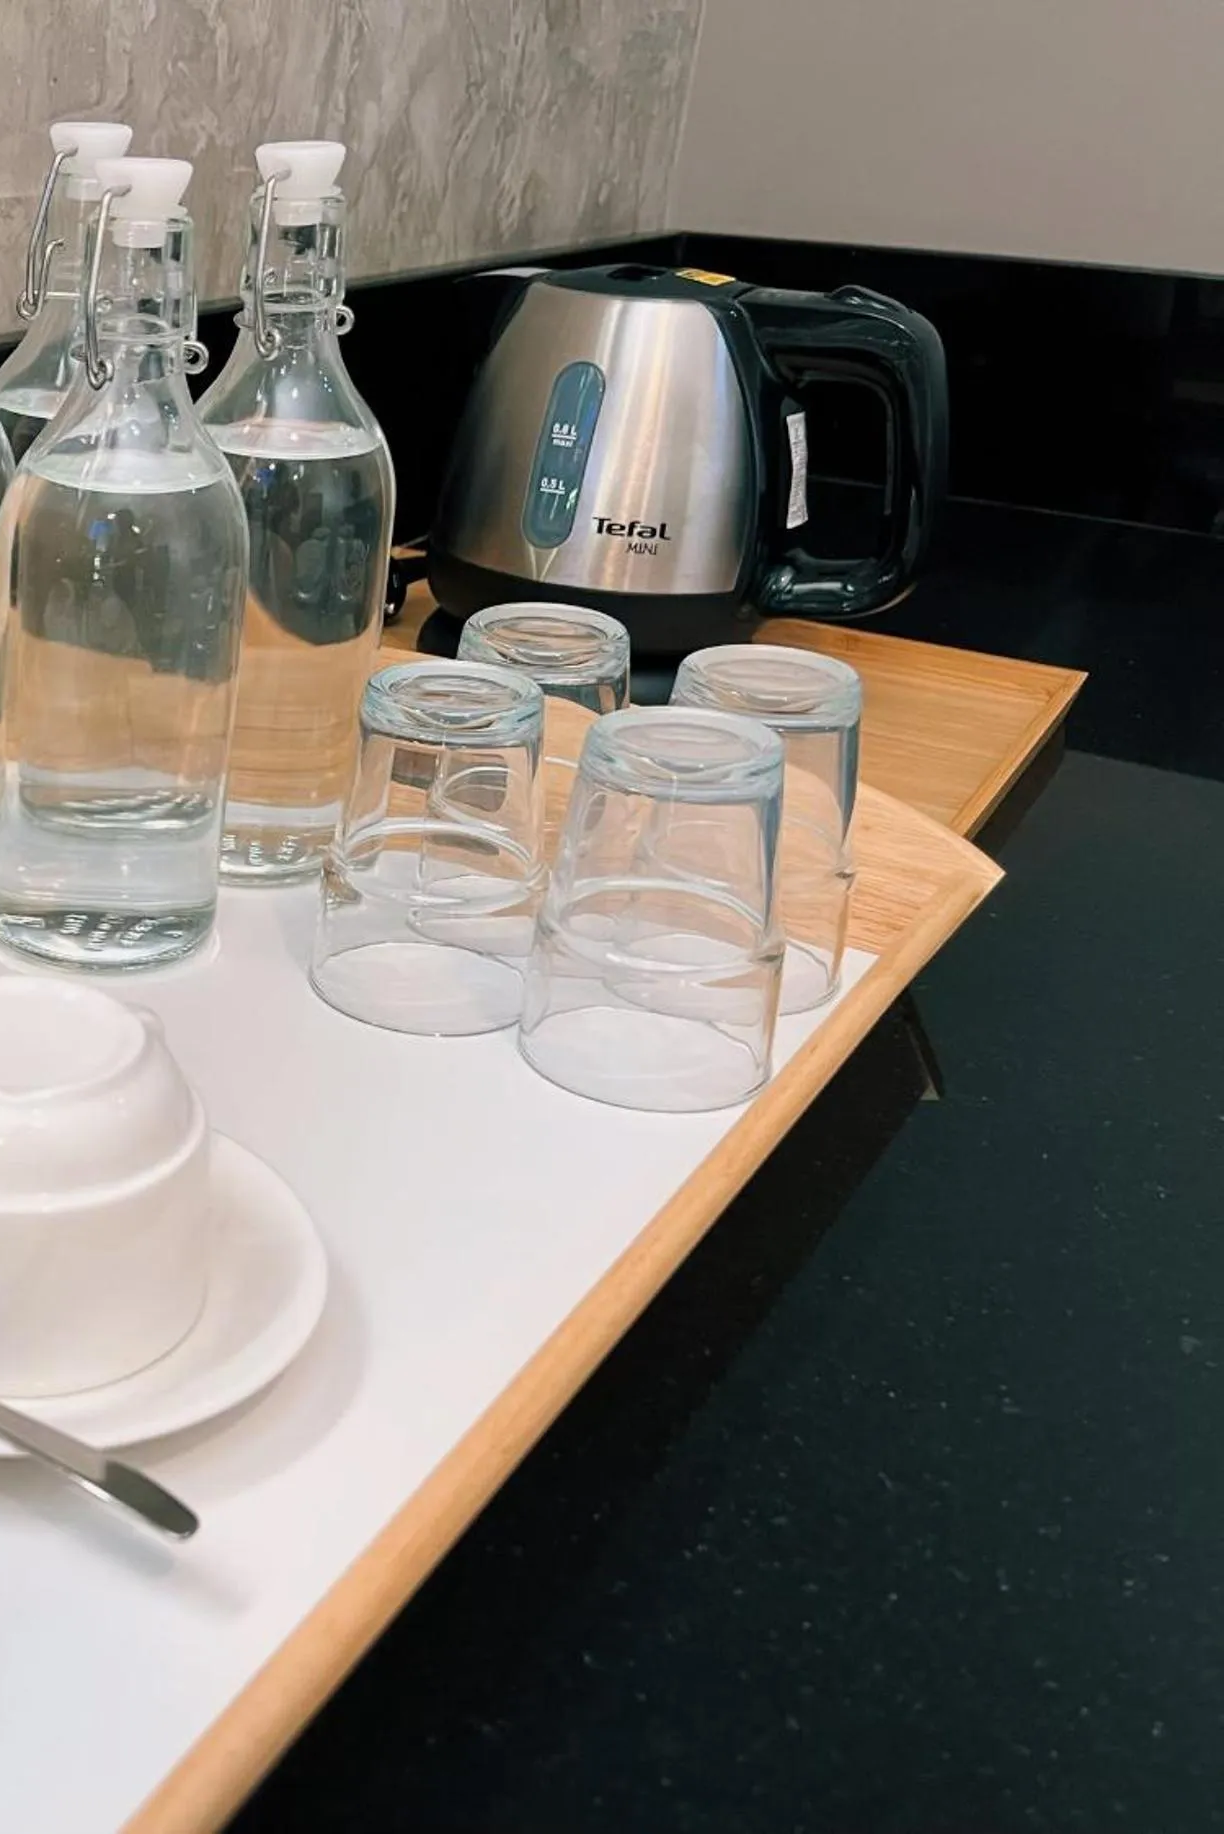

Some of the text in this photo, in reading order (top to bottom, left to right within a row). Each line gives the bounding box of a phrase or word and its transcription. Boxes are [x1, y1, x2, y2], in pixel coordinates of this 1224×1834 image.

[571, 424, 577, 436] L
[541, 477, 566, 490] 0.5 L
[592, 517, 672, 541] Tefal
[626, 543, 658, 555] MINI
